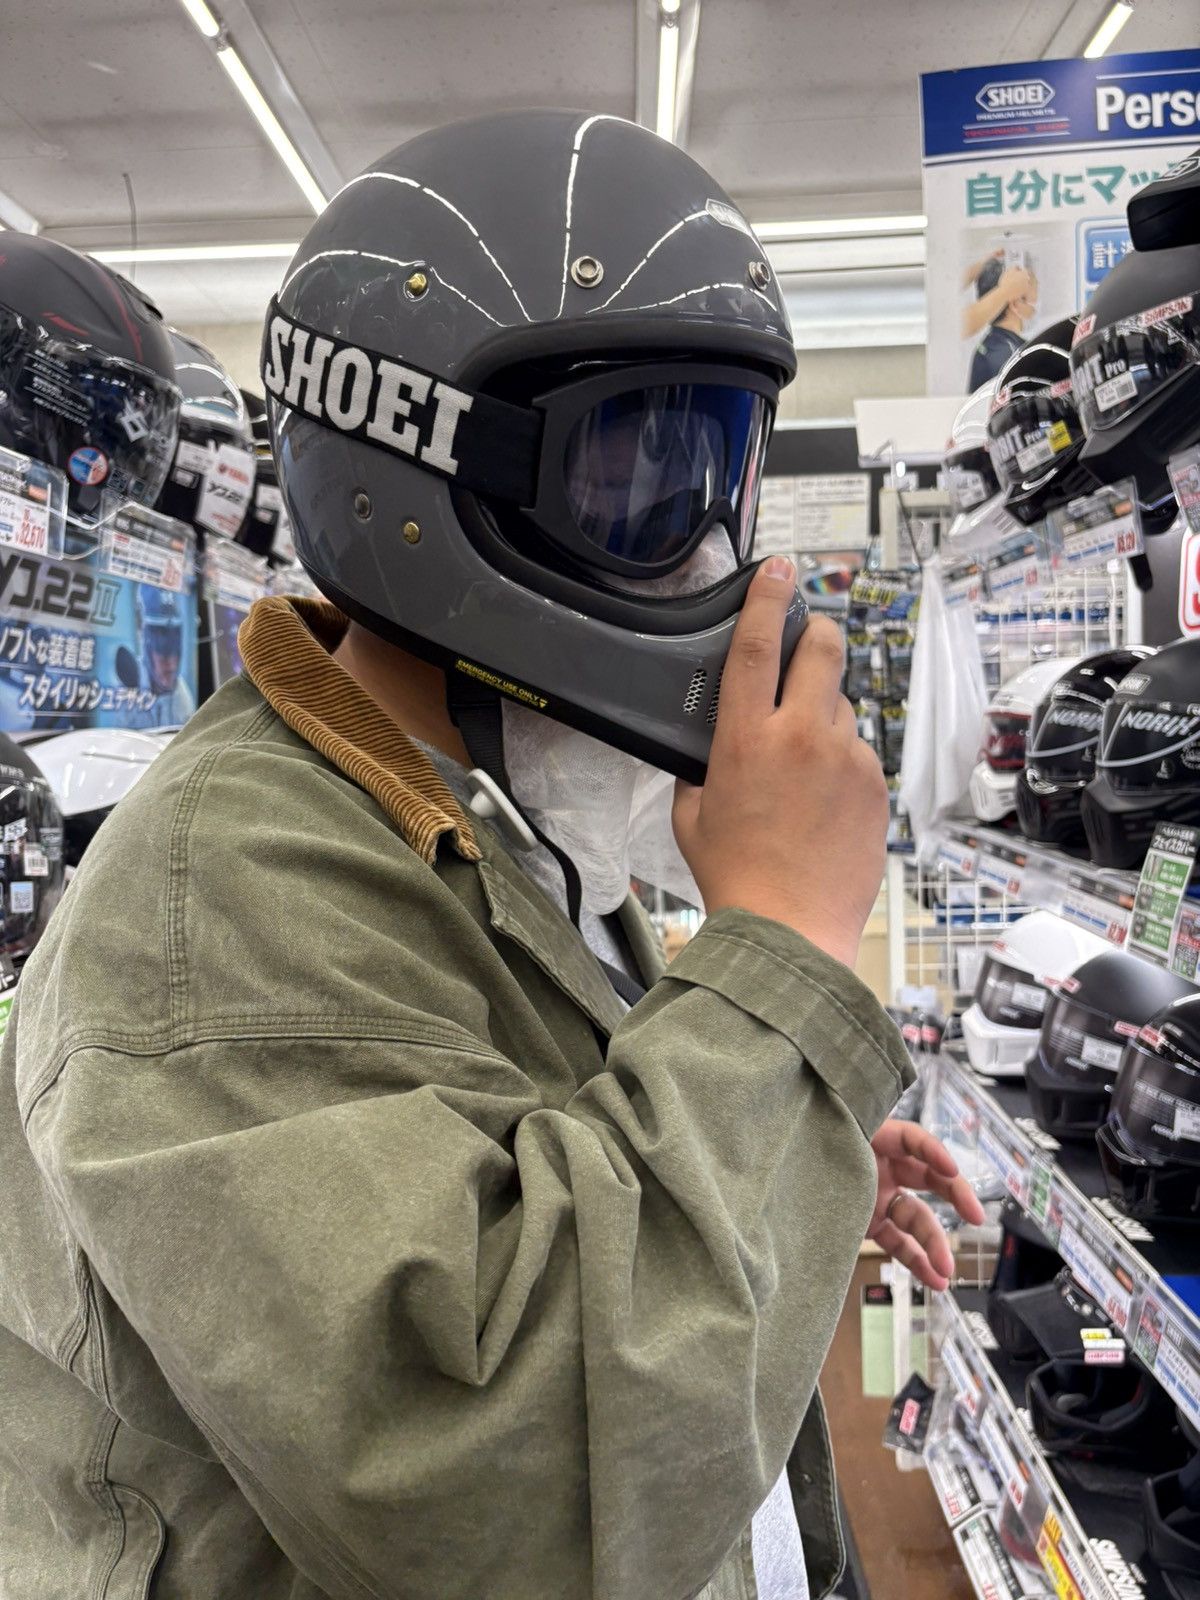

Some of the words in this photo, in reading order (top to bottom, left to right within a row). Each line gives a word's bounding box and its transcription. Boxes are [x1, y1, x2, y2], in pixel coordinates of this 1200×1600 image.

[987, 84, 1044, 108] SHOEI
[1096, 85, 1200, 132] Pers
[966, 162, 1180, 217] 自分にマッ
[265, 316, 474, 475] SHOEI
[18, 673, 157, 711] スタイリッシュデザイン
[457, 659, 502, 685] EMERGENCY
[502, 681, 518, 693] USE
[518, 688, 540, 701] ONLY
